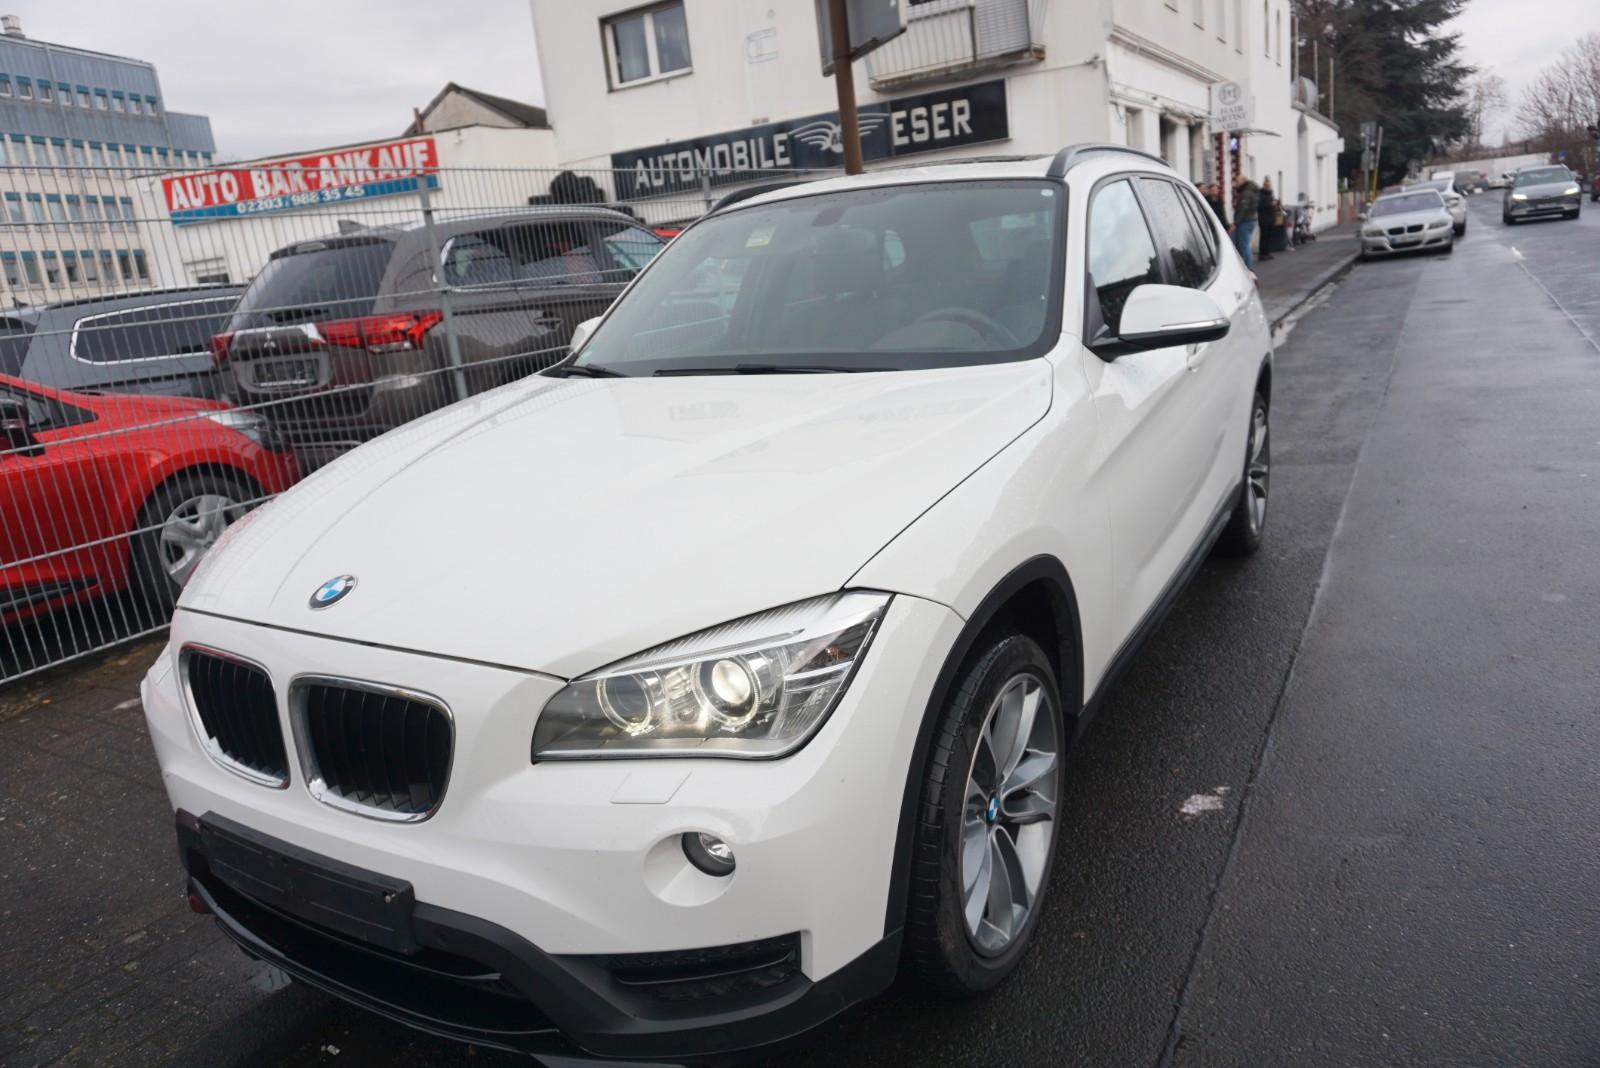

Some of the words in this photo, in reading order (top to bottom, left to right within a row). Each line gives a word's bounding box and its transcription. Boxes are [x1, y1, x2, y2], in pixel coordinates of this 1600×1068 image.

[891, 98, 973, 146] ESER
[171, 170, 239, 210] AUTO
[250, 141, 429, 197] BAR-ANKAUF
[634, 132, 791, 191] AUTOMOBILE
[236, 196, 283, 214] 02203
[322, 188, 341, 201] 35
[345, 184, 364, 197] 45
